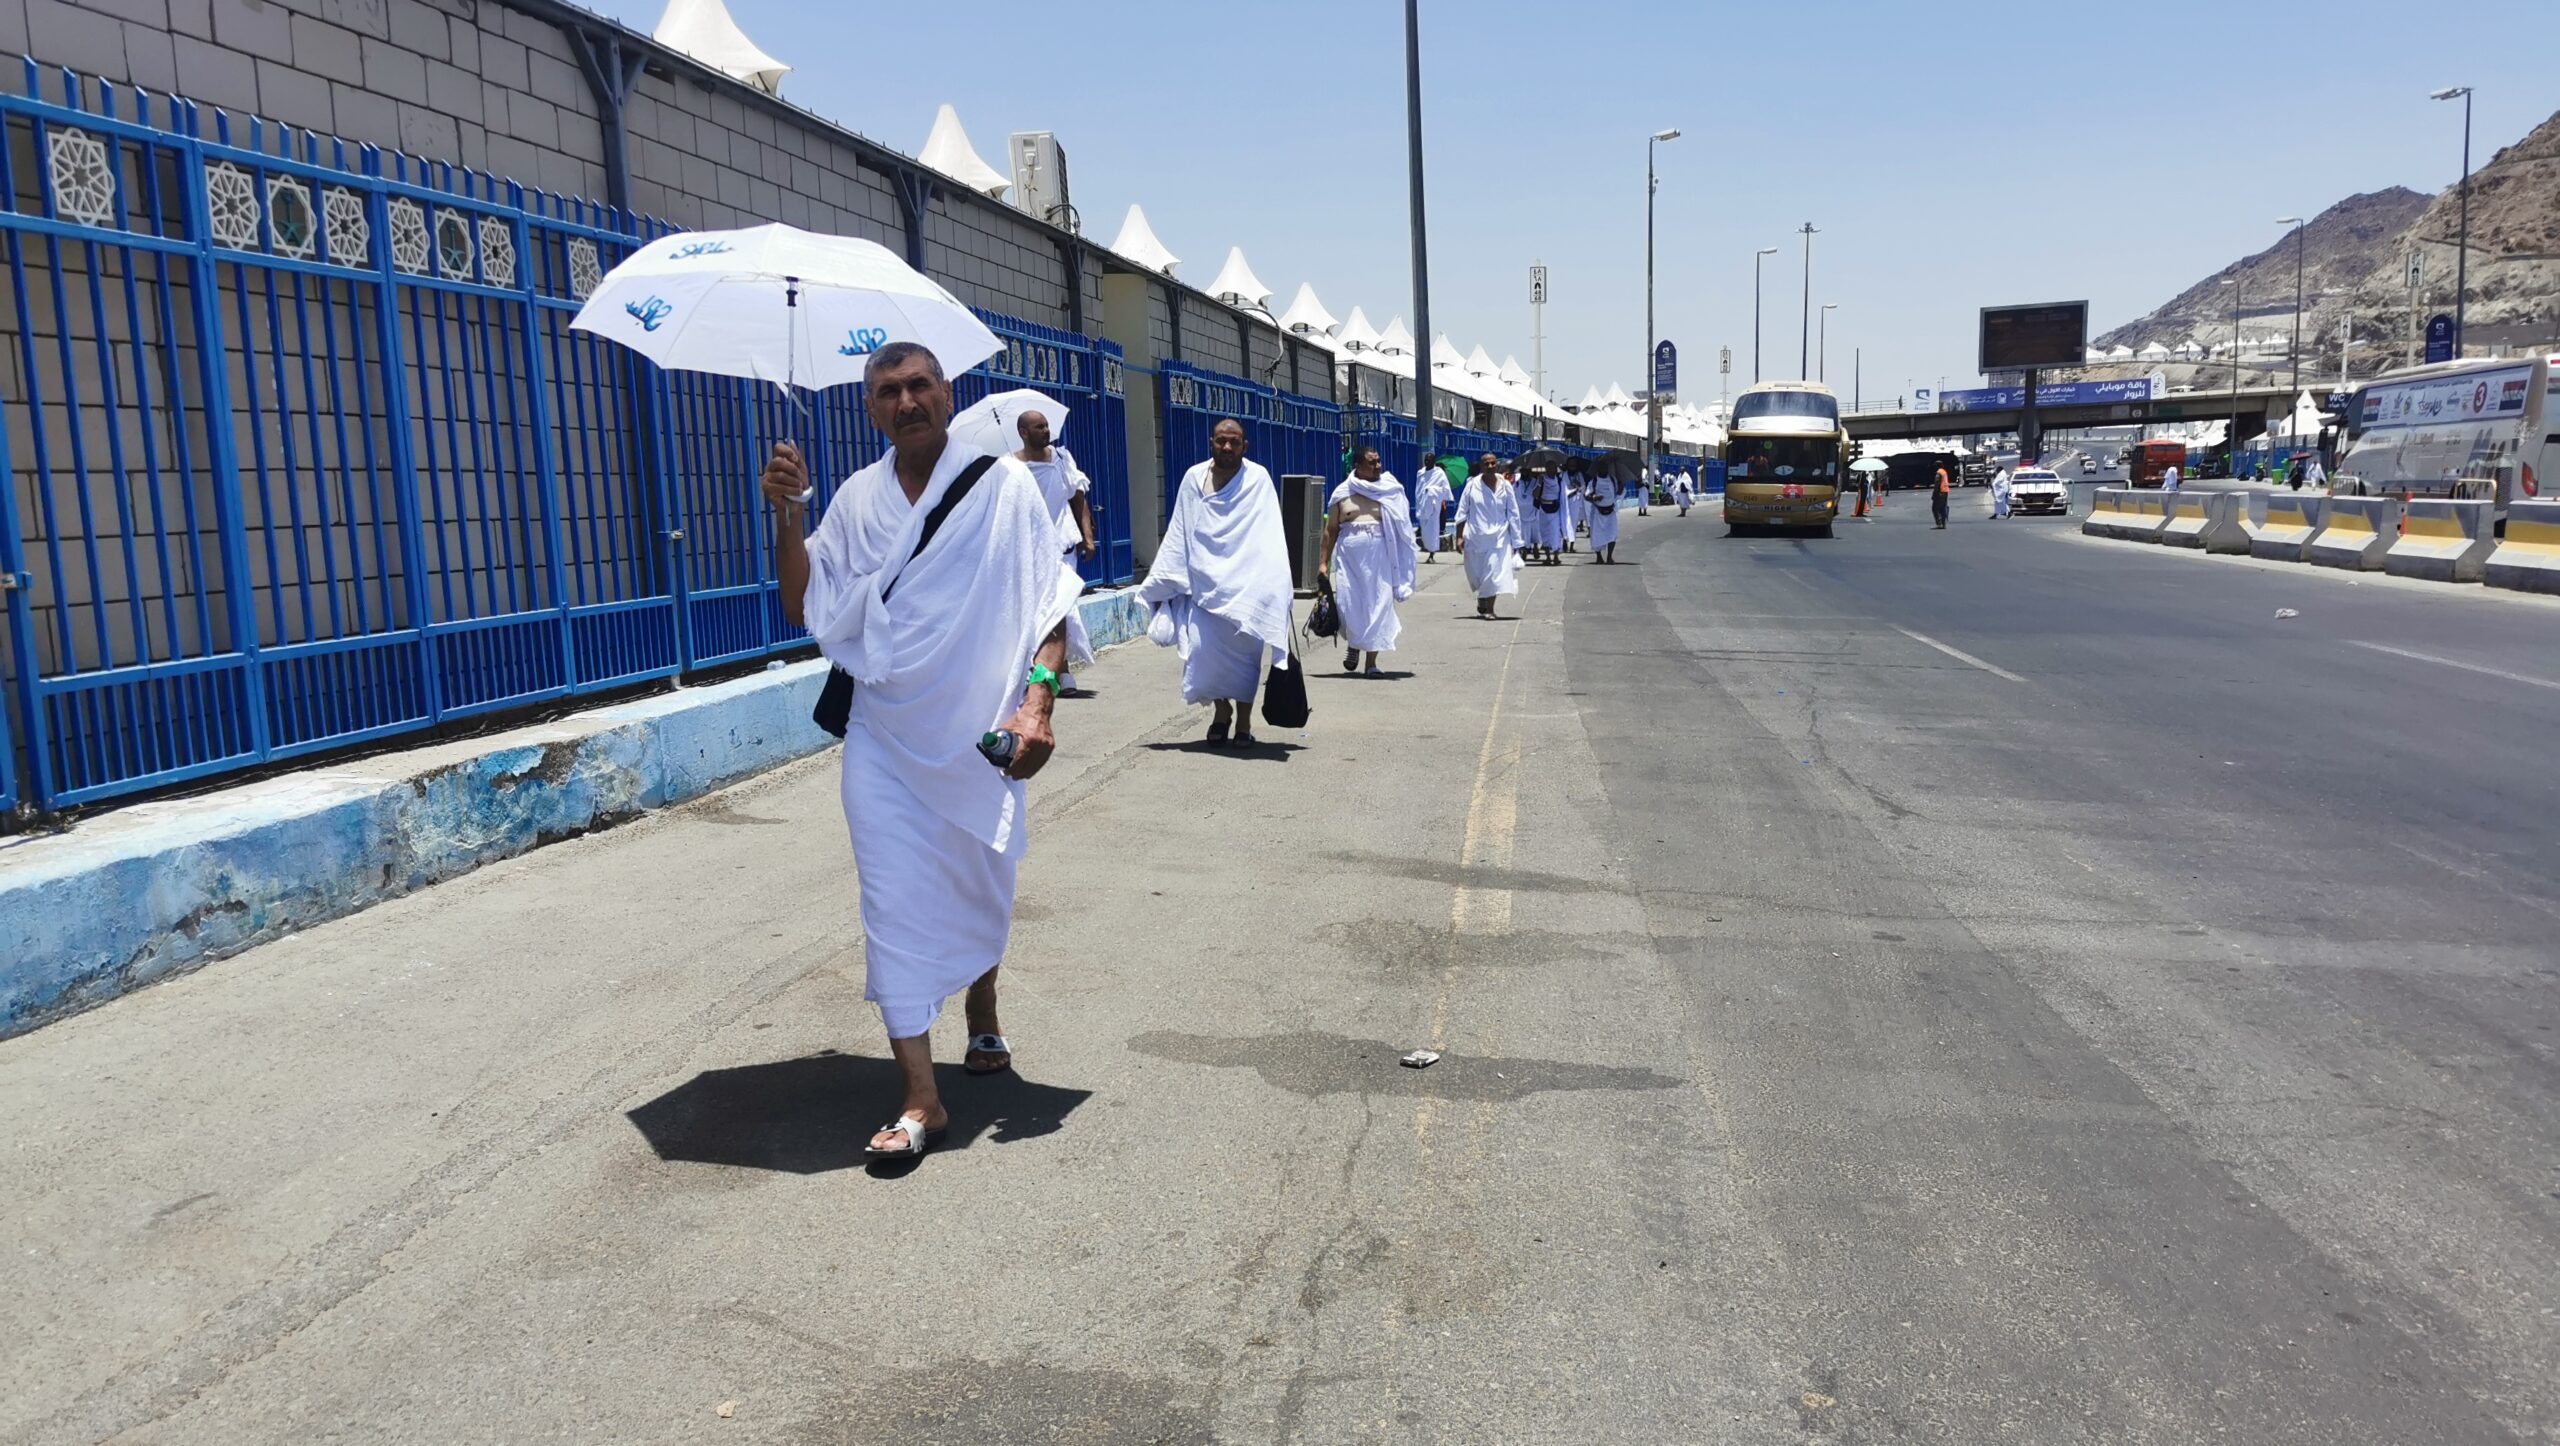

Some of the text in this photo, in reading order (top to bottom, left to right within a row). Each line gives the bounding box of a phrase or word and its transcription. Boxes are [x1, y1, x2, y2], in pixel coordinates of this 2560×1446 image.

[2095, 382, 2126, 394] موبايلي
[2127, 381, 2146, 389] باقة
[2328, 393, 2345, 402] WC
